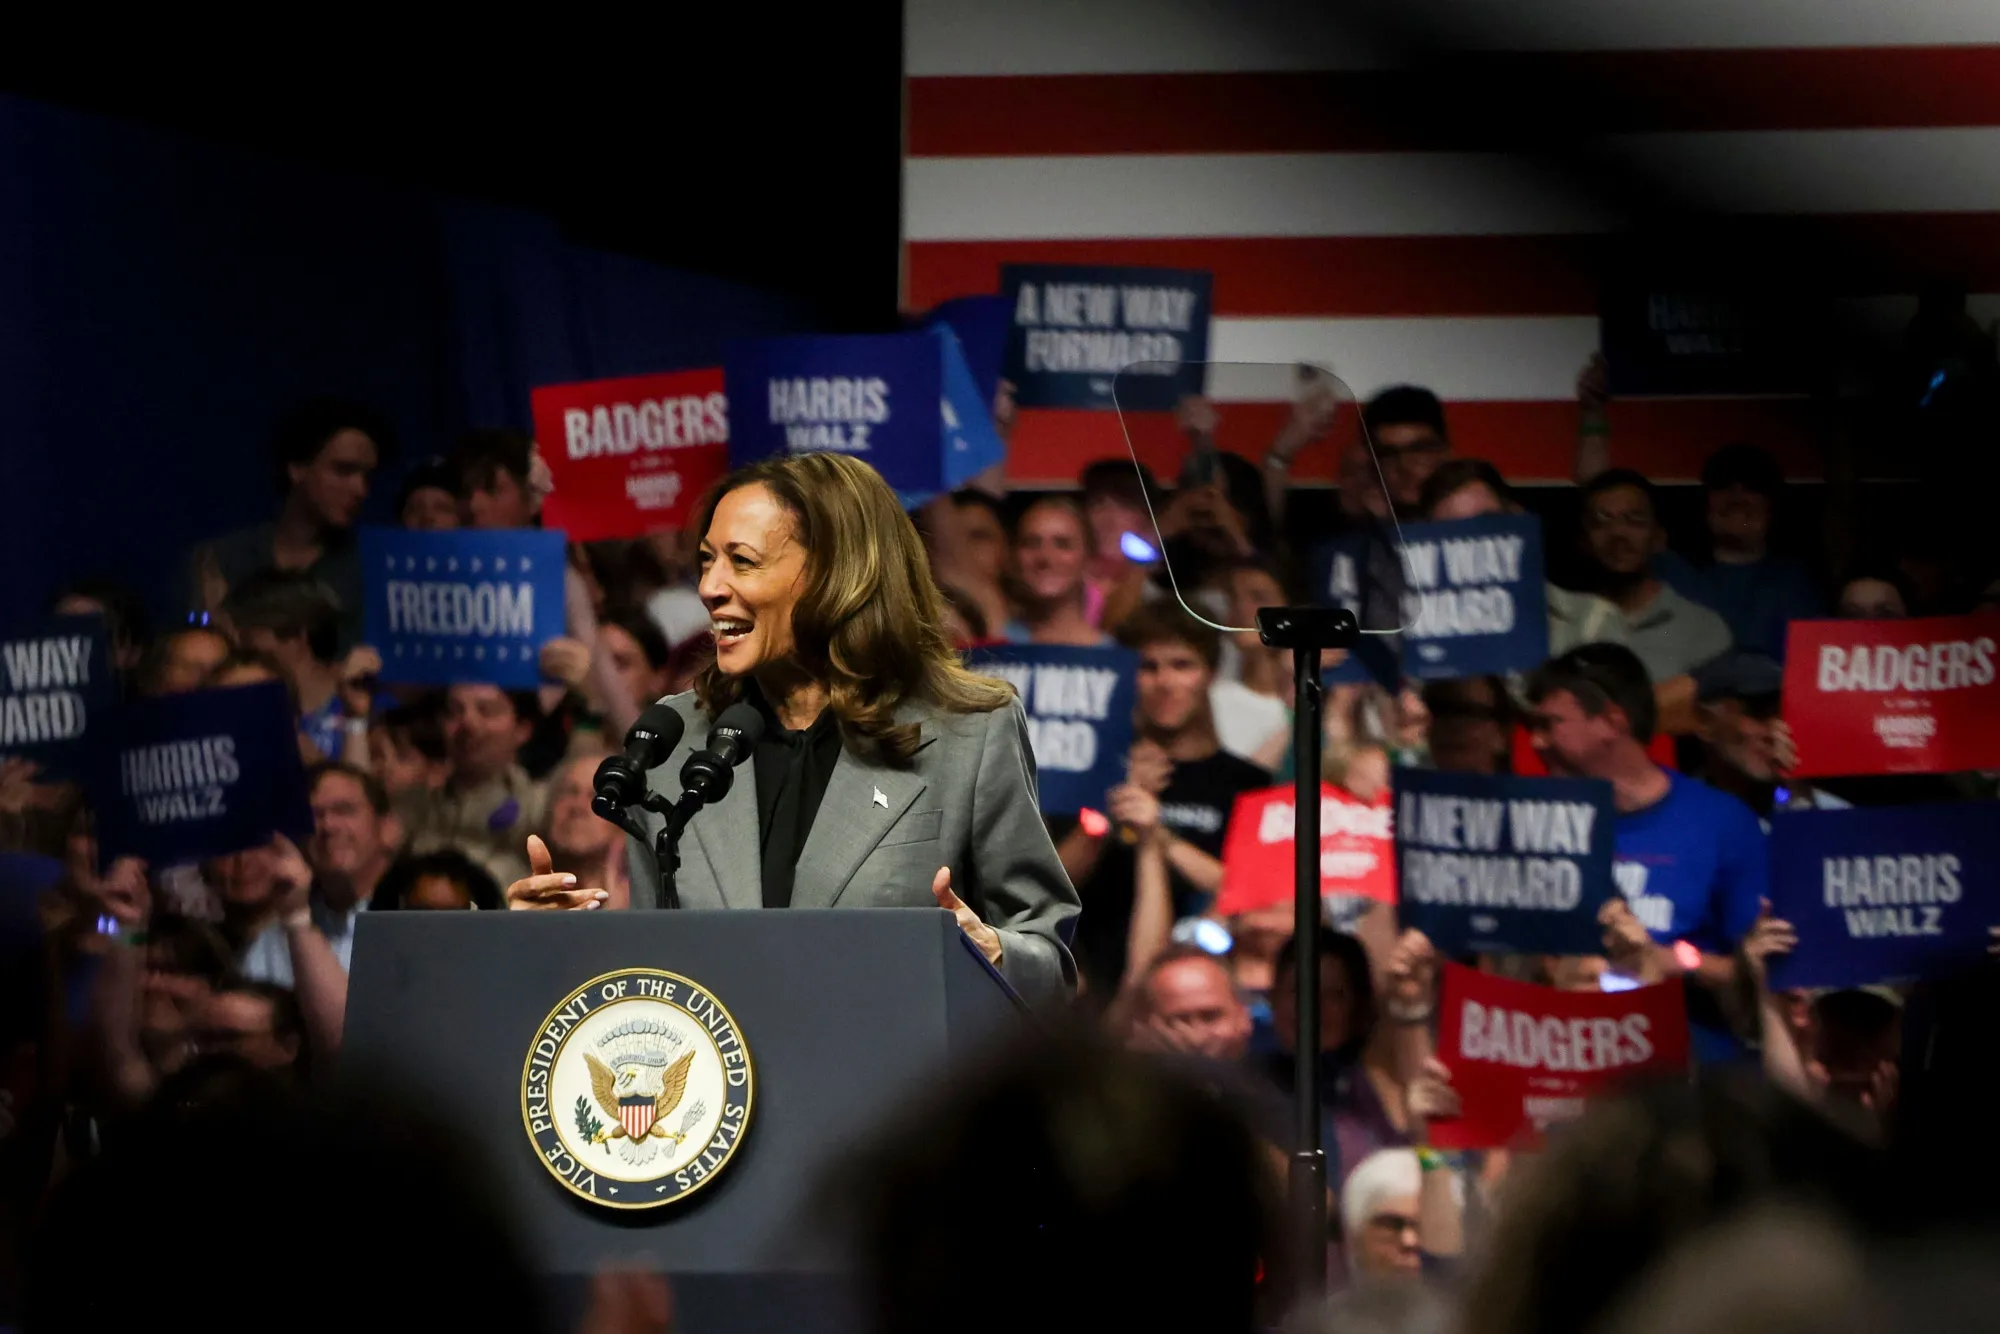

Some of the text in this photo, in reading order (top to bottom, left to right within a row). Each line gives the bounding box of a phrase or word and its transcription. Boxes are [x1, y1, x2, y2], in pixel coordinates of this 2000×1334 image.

[1014, 281, 1198, 332] A NEW WAY
[1024, 328, 1183, 376] FORWARD
[563, 391, 730, 461] BADGERS
[768, 376, 890, 425] HARRIS
[785, 424, 873, 450] WALZ
[1441, 531, 1525, 585] WAY
[386, 578, 534, 638] FREEDOM
[3, 634, 93, 691] WAY
[1816, 636, 1997, 693] BADGERS
[0, 689, 87, 748] ARD
[1033, 661, 1120, 722] WAY
[119, 733, 241, 797] HARRIS
[135, 787, 228, 826] WALZ
[1417, 792, 1504, 852] NEW
[1507, 798, 1597, 856] WAY
[1402, 848, 1584, 912] FORWARD
[1822, 853, 1964, 909] HARRIS
[1844, 906, 1945, 939] WALZ
[1458, 997, 1656, 1073] BADGERS
[528, 978, 747, 1197] VICE PRESIDENT OF THE UNITED STATES
